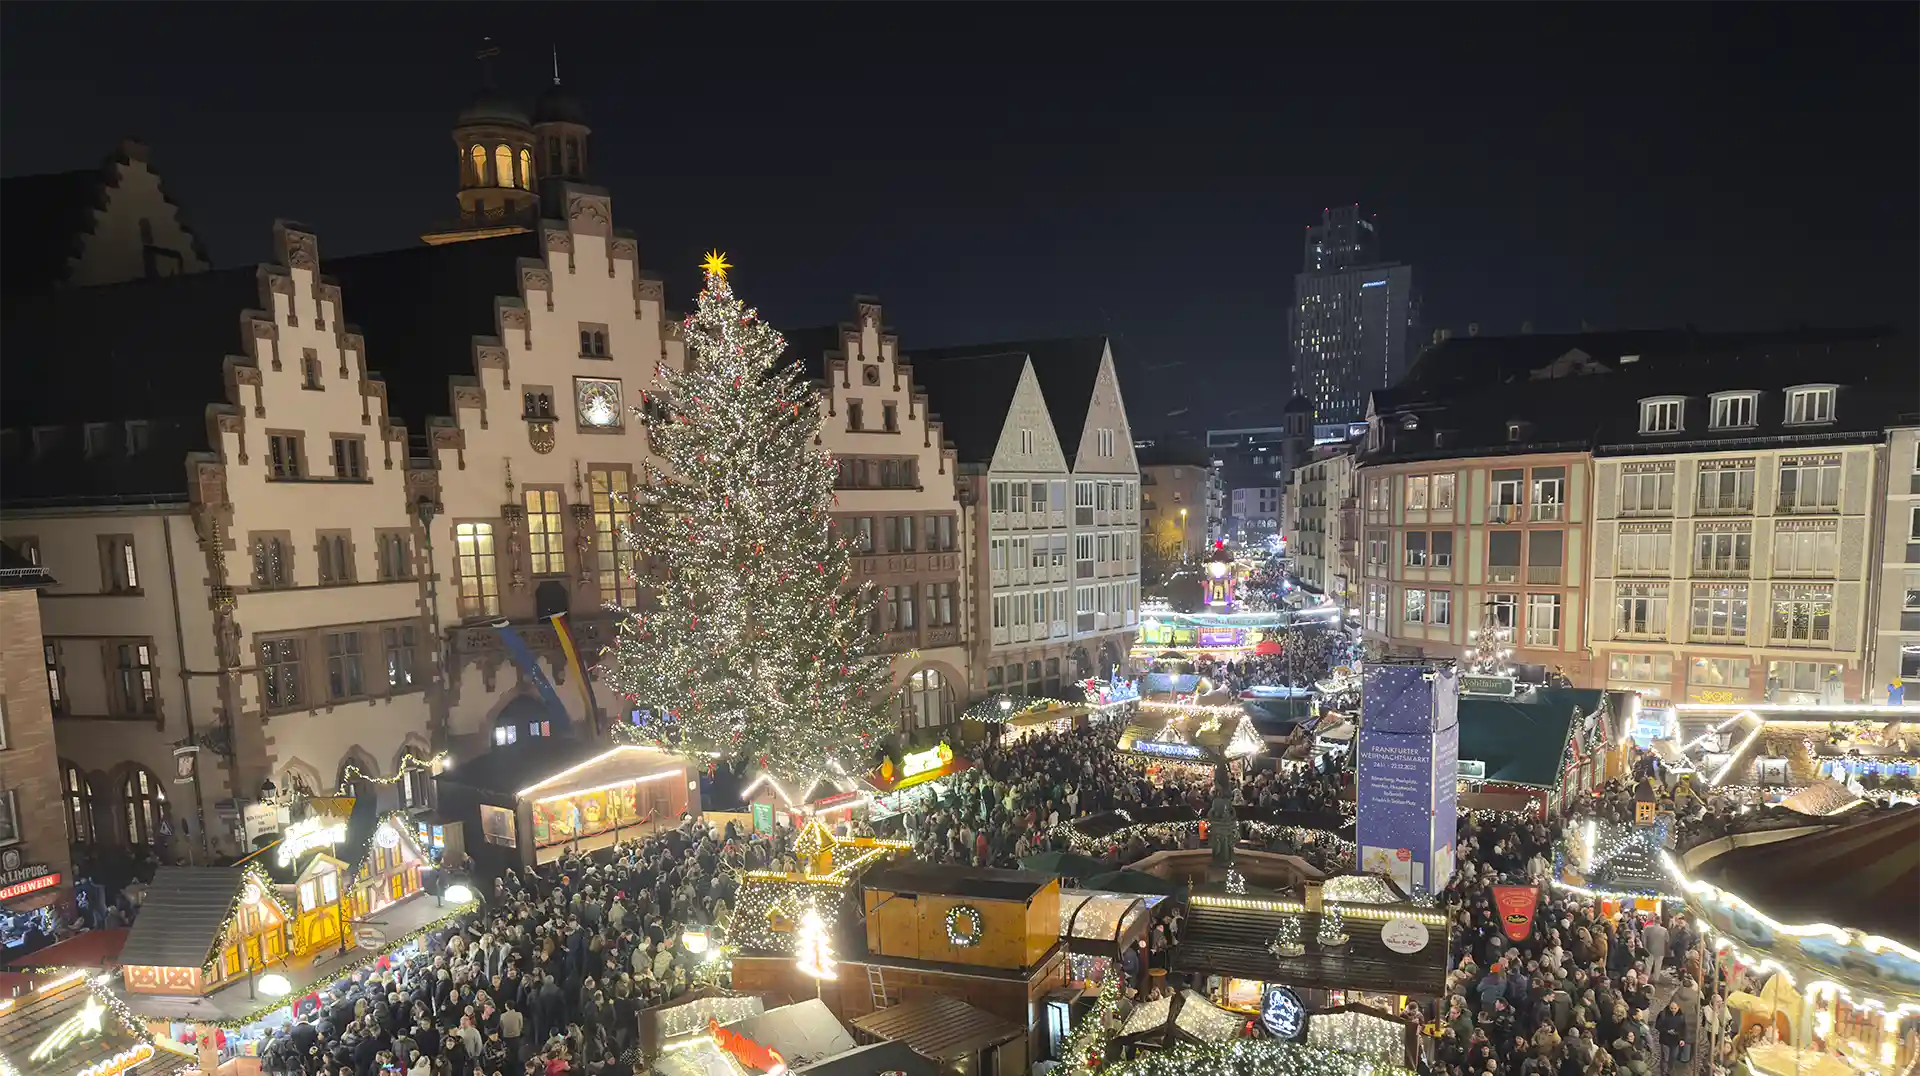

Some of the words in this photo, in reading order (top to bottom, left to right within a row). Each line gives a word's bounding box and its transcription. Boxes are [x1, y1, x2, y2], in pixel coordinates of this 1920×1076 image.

[1371, 745, 1419, 756] FRANKFURTER
[1360, 752, 1430, 764] WEIHNACHTSMARKT
[8, 864, 48, 882] LIMPURG
